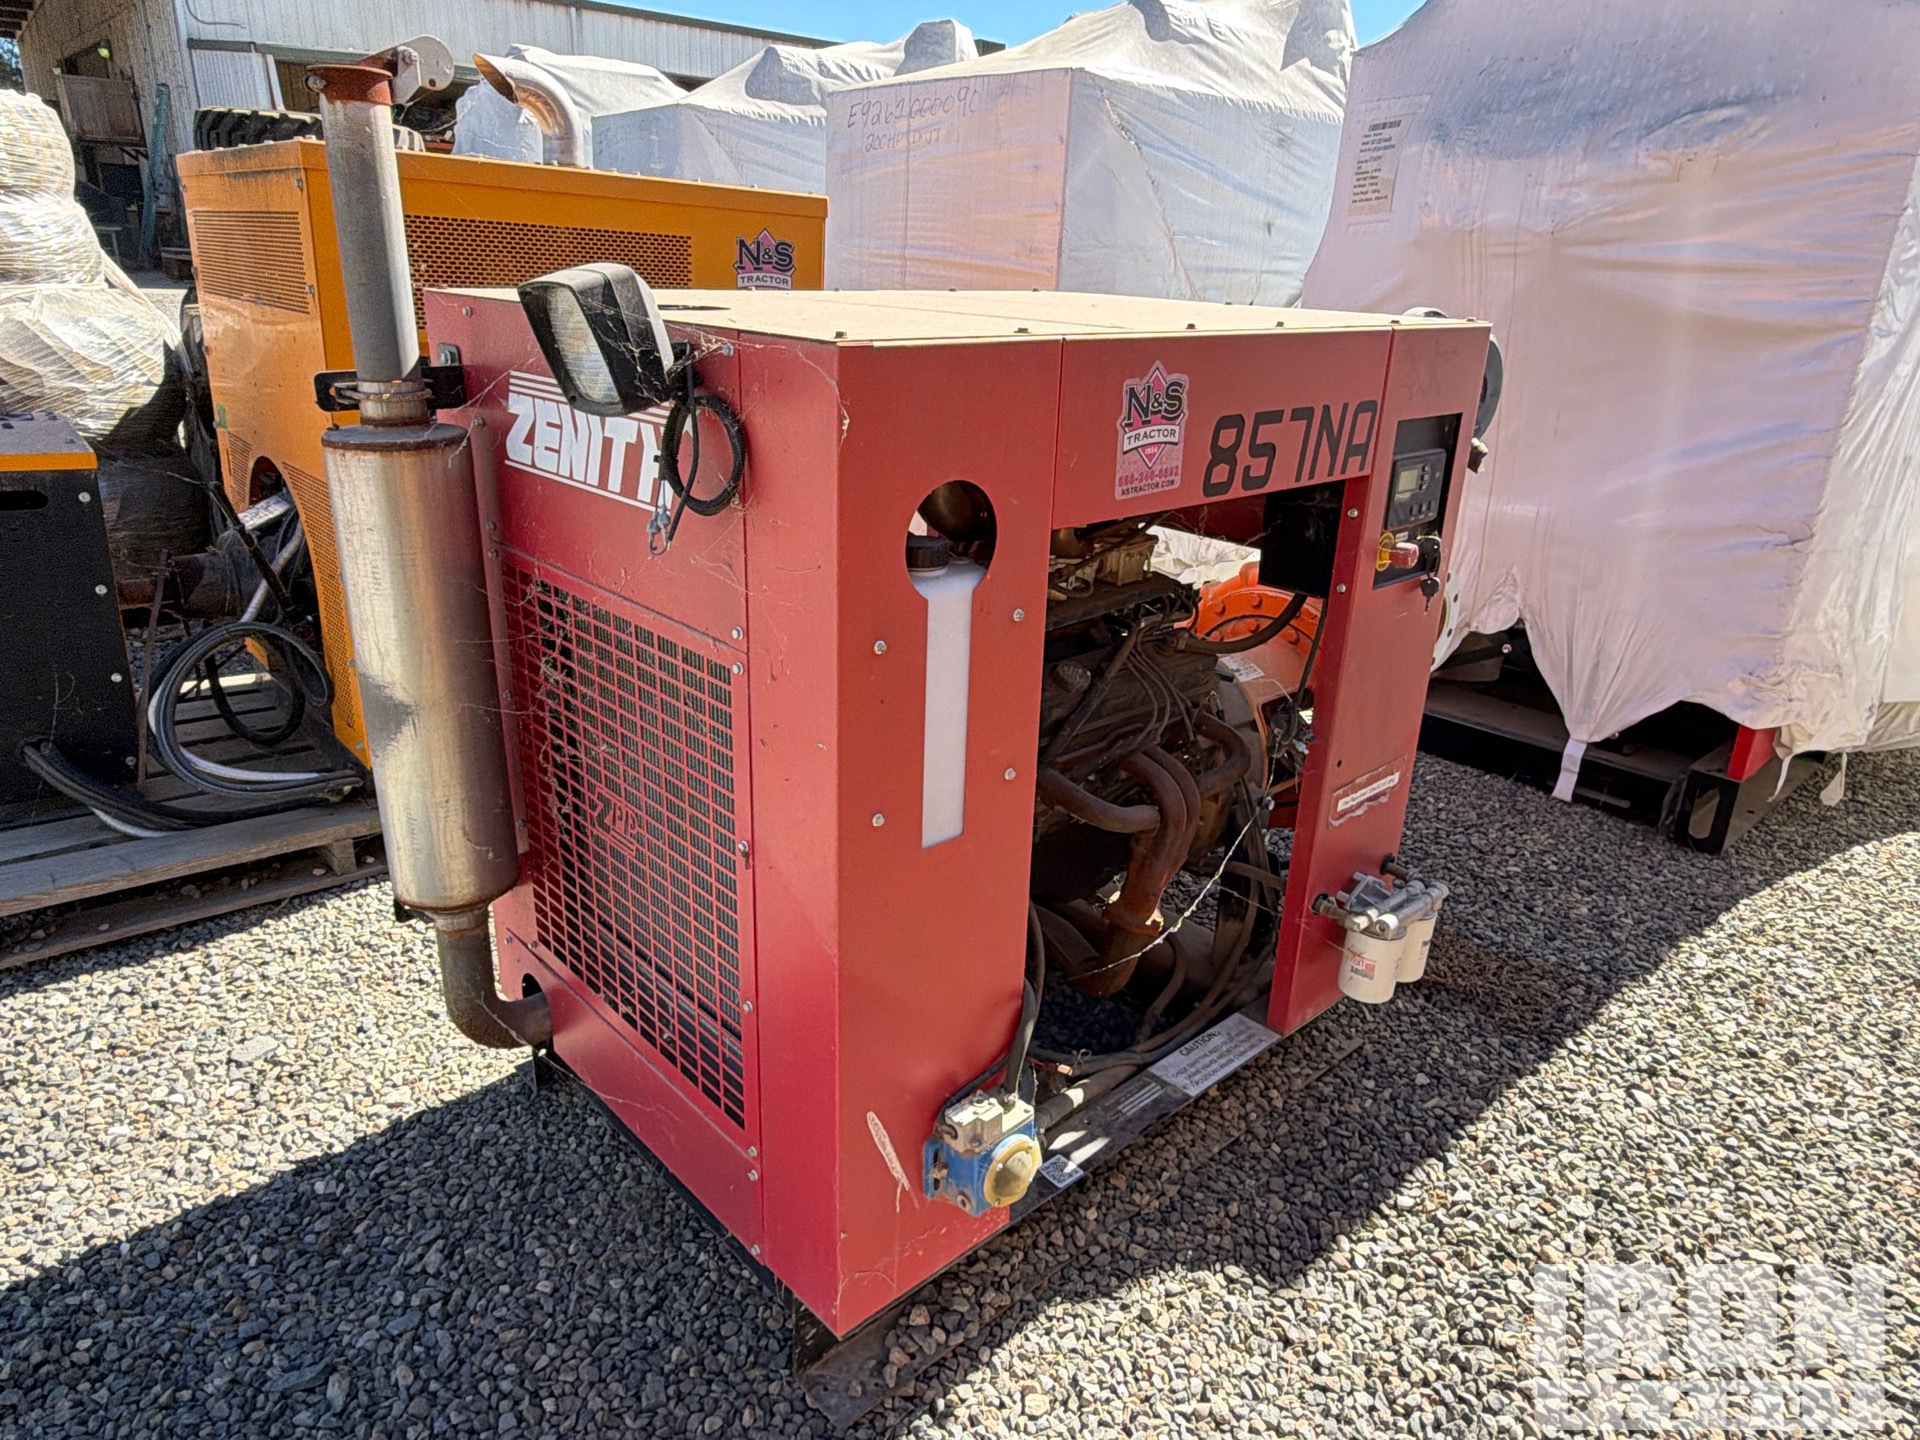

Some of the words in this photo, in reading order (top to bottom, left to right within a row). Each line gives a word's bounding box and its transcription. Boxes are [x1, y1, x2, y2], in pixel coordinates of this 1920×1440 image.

[736, 237, 795, 273] N&S
[740, 275, 789, 287] TRACTOR
[1124, 379, 1185, 425] N&S
[506, 392, 674, 510] ZENITH
[1127, 428, 1176, 446] TRACTOR
[1203, 399, 1378, 498] 857NA
[1121, 479, 1175, 496] NSTRACTOR.COM
